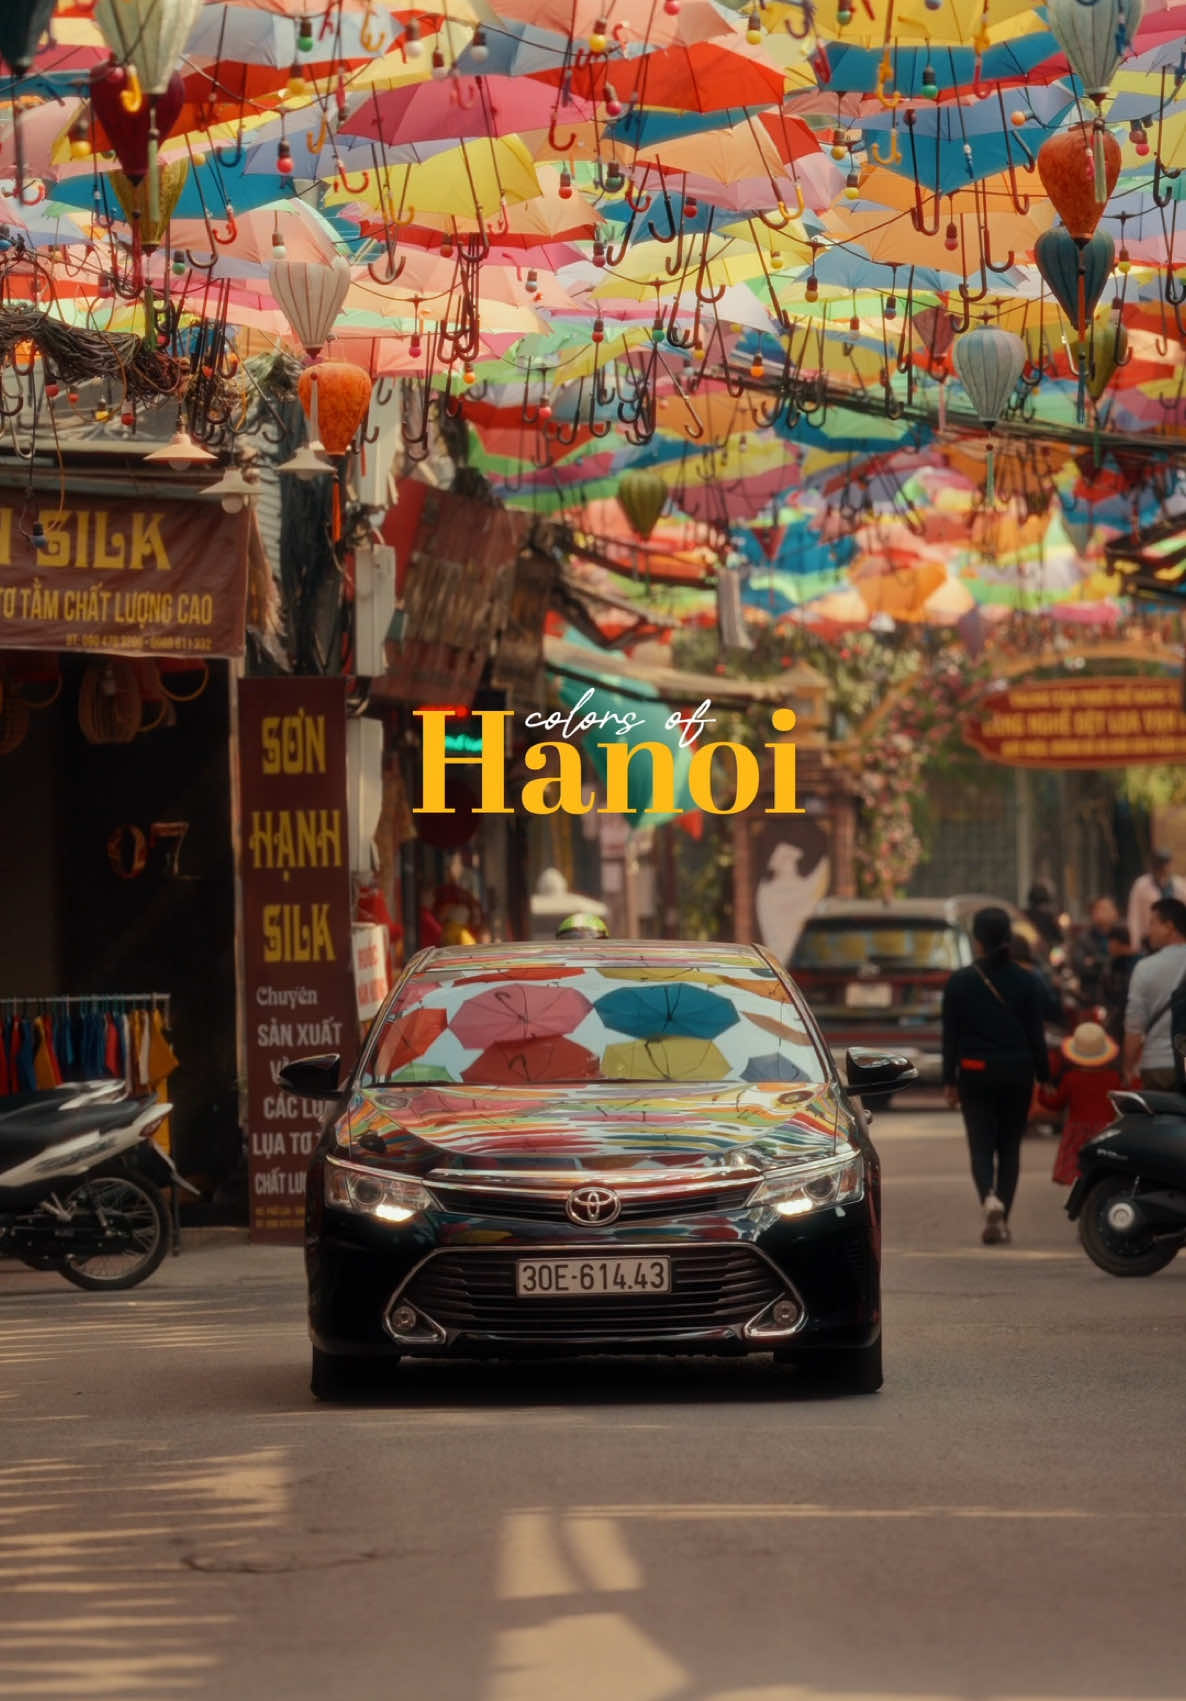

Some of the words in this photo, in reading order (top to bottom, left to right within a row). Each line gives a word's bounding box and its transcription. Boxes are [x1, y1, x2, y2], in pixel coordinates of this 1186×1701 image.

[36, 509, 171, 570] SILK
[0, 586, 16, 619] Ơ
[64, 580, 111, 622] CHẤT
[115, 591, 173, 629] LƯỢNG
[178, 593, 213, 625] CAO
[261, 707, 327, 775] SƠN
[249, 810, 343, 882] HẠNH
[263, 904, 336, 963] SILK
[256, 986, 318, 1010] Chuyên
[257, 1017, 293, 1047] SẢN
[296, 1016, 343, 1046] XUẤT
[263, 1090, 297, 1119] CÁC
[252, 1132, 286, 1159] LỤA
[289, 1131, 313, 1155] TƠ
[255, 1166, 286, 1195] CHẤT
[522, 1262, 664, 1291] 30E-614.43
